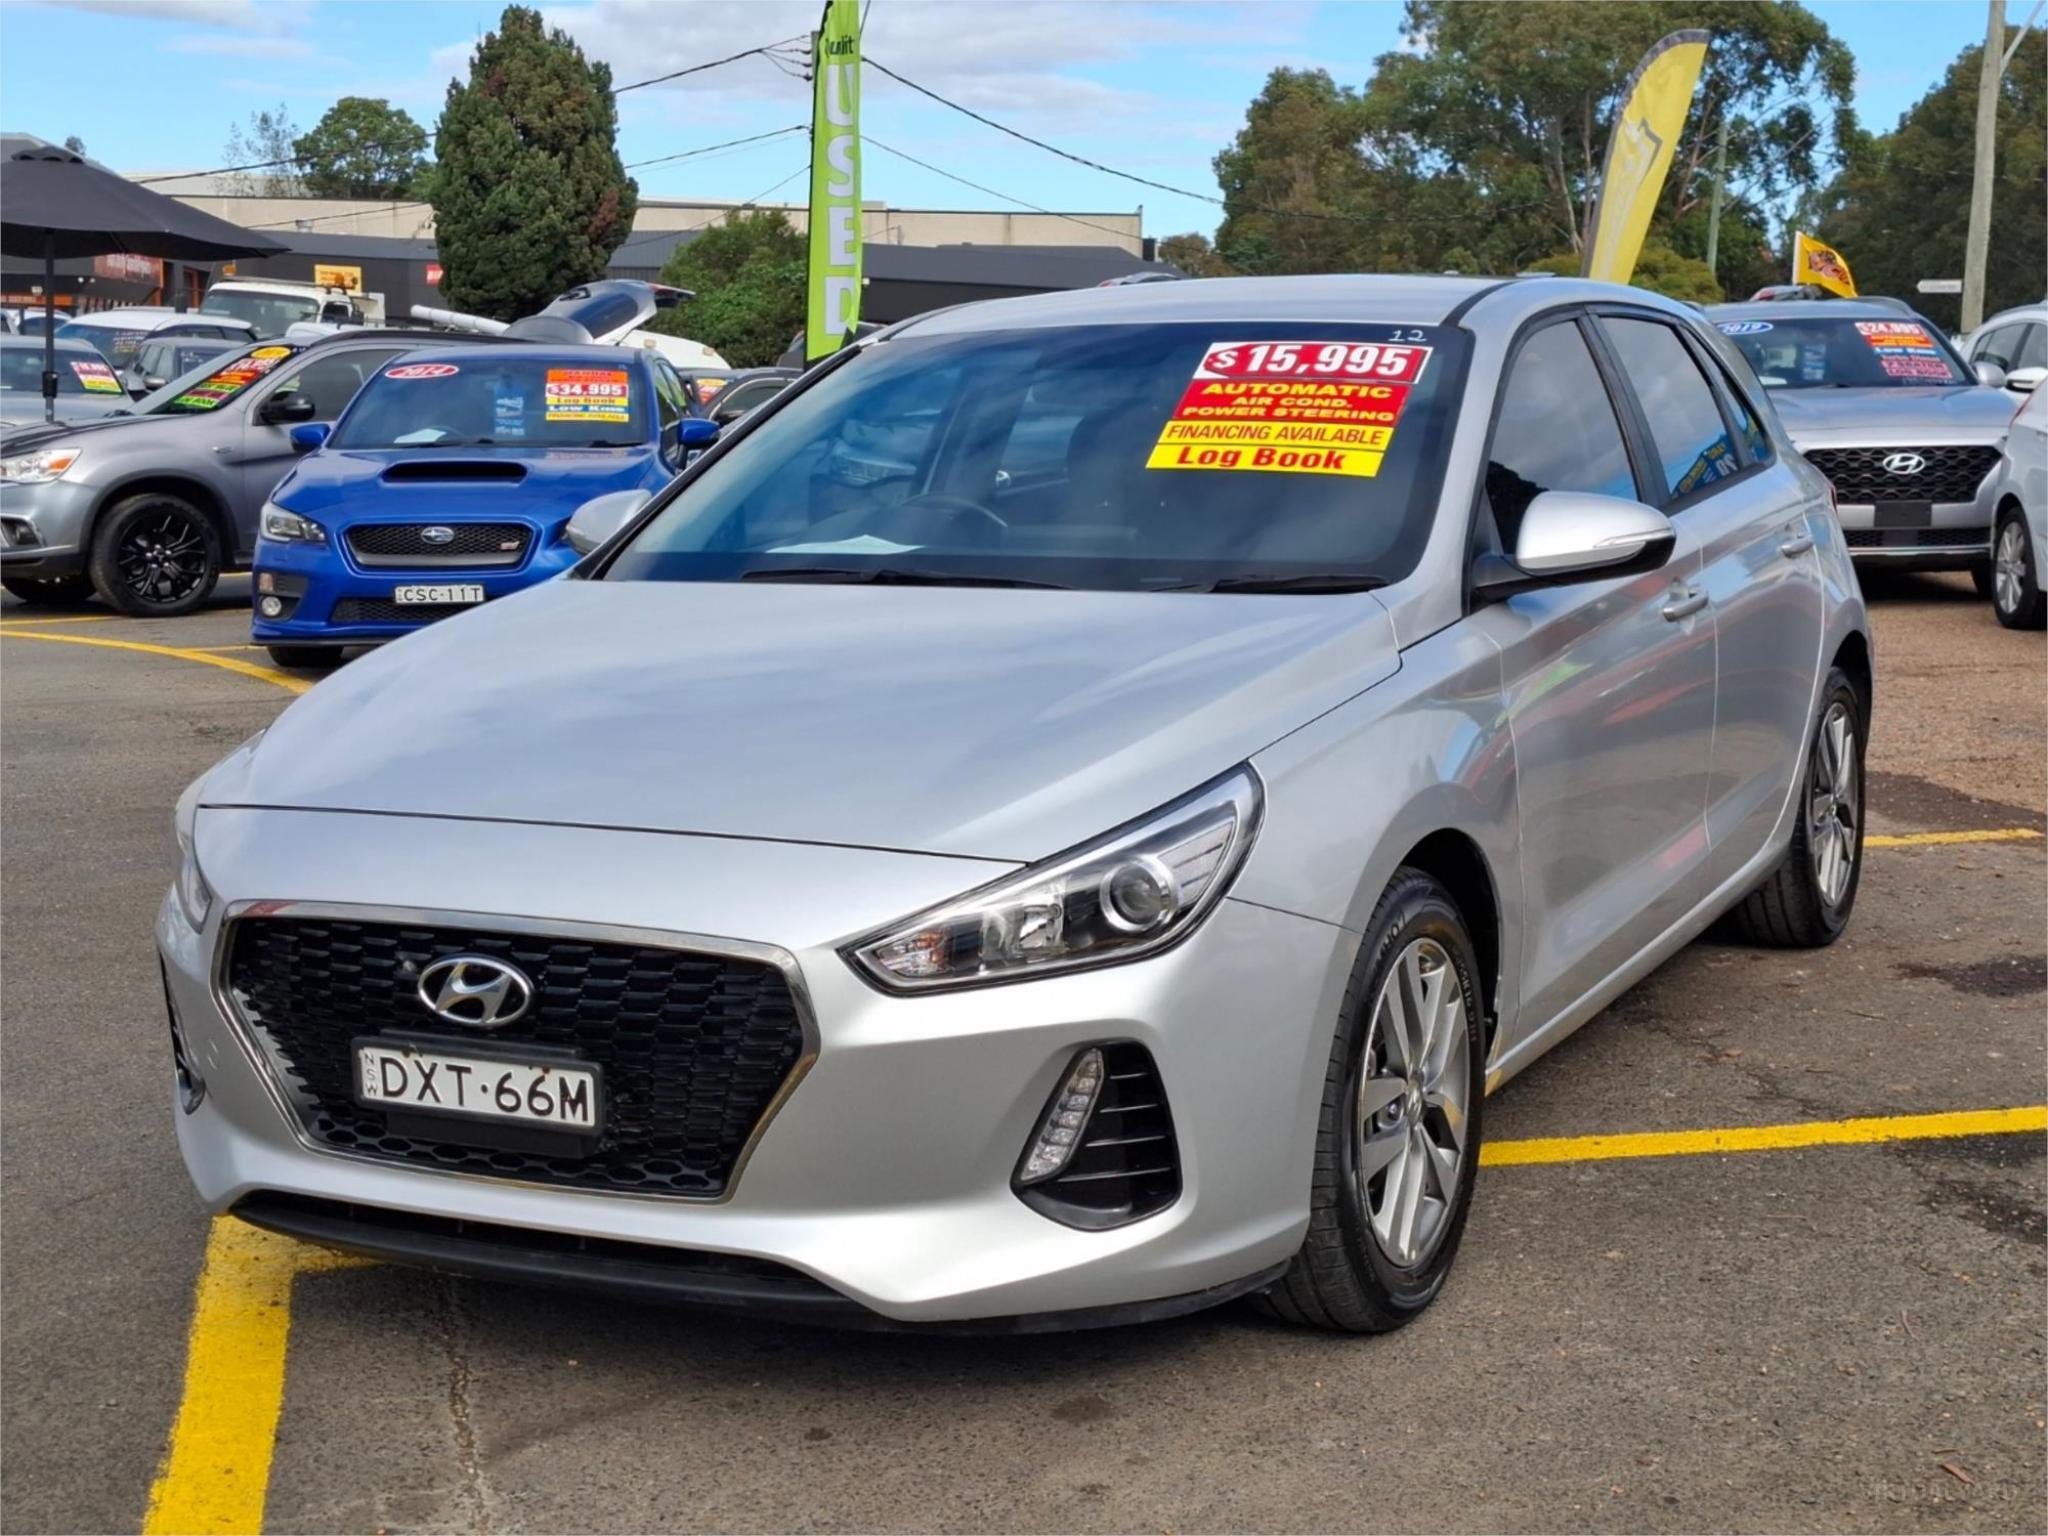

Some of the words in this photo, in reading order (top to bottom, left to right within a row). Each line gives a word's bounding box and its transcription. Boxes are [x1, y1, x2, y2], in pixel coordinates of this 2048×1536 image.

[825, 62, 858, 337] USED
[1202, 383, 1393, 399] AUTOMATIC
[1232, 396, 1276, 407] AIR
[1280, 397, 1352, 409] COND.
[1182, 406, 1267, 418] POWER
[1273, 407, 1395, 422] STEERING
[1167, 425, 1270, 441] FINANCING
[1275, 428, 1385, 446] AVAILABLE
[1177, 447, 1243, 469] Log
[1251, 448, 1346, 470] Book
[363, 1052, 379, 1097] NSW
